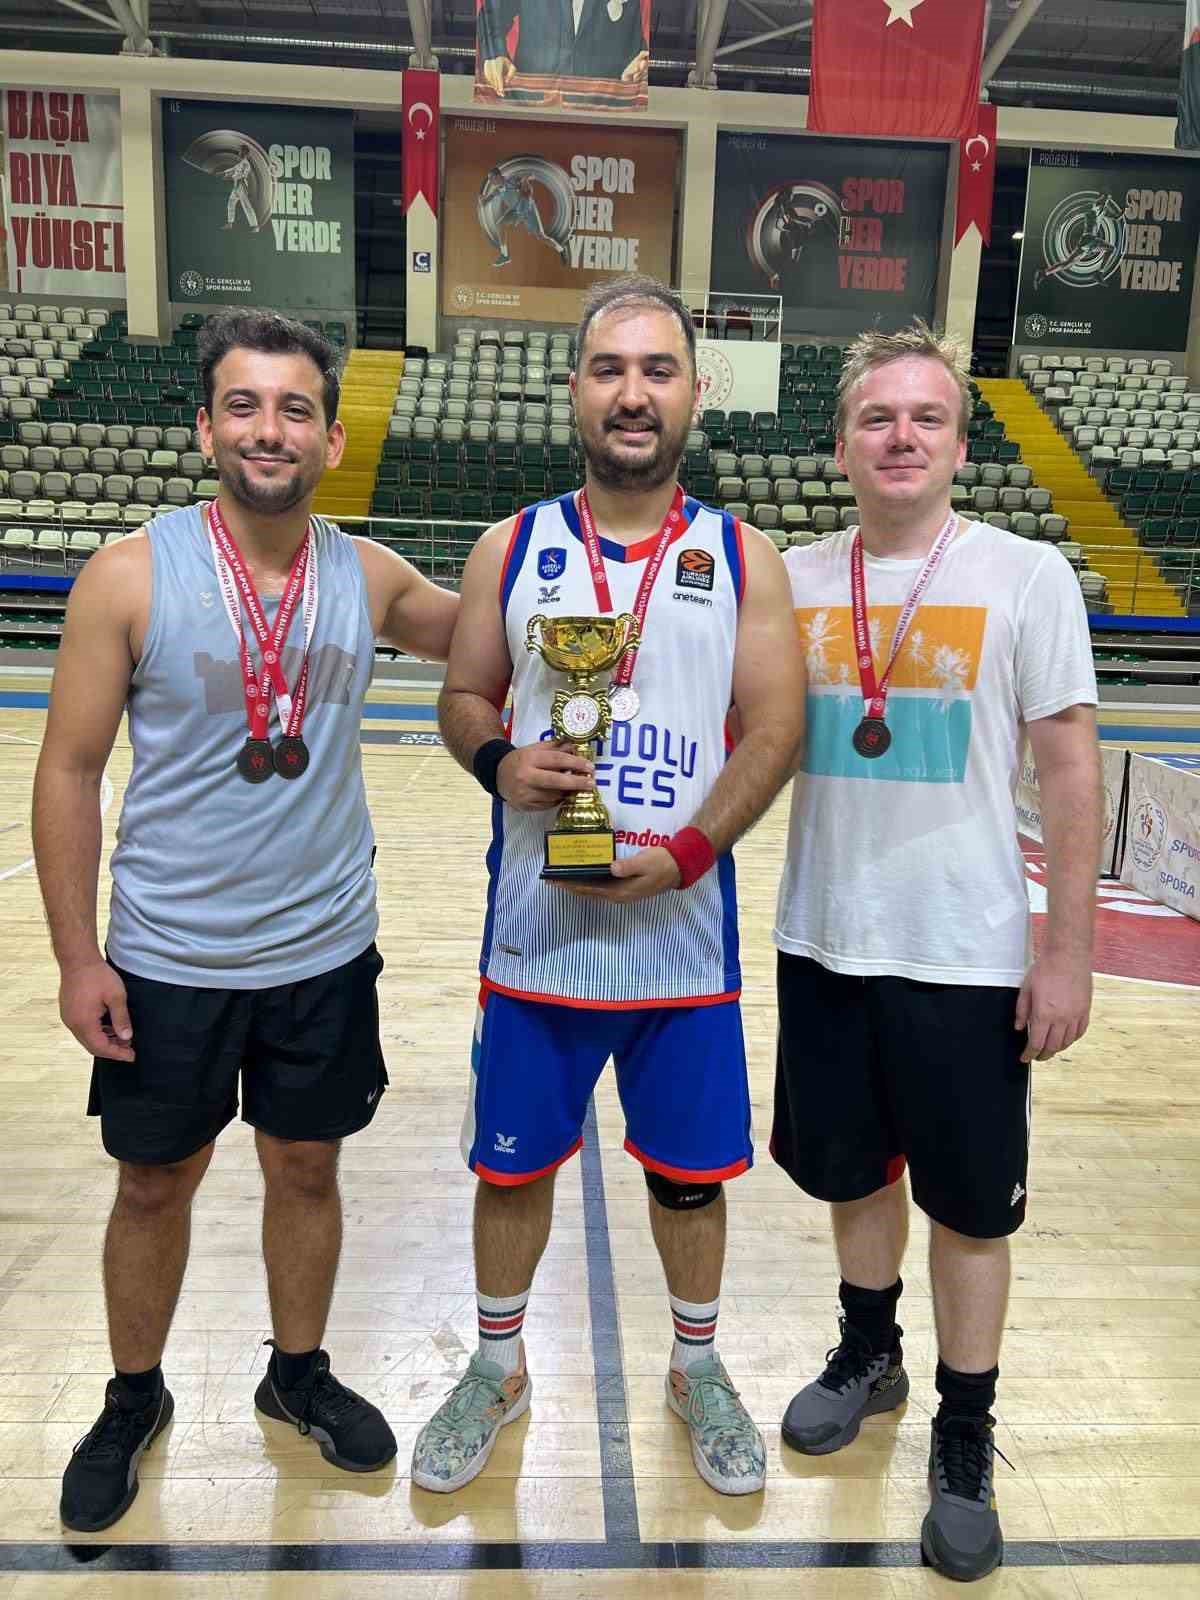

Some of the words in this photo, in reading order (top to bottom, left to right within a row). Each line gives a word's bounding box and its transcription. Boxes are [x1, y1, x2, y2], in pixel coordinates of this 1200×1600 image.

[8, 90, 89, 147] BAŞA
[10, 152, 78, 207] RIYA
[269, 144, 332, 180] SPOR
[570, 155, 635, 194] SPOR
[271, 182, 313, 216] HER
[842, 177, 905, 214] SPOR
[1125, 189, 1183, 221] SPOR
[571, 195, 614, 232] HER
[11, 212, 126, 272] YÜKSEL
[271, 219, 341, 254] YERDE
[840, 216, 882, 251] HER
[1124, 223, 1162, 256] HER
[415, 252, 428, 266] C
[568, 235, 640, 272] YERDE
[838, 255, 907, 291] YERDE
[1120, 259, 1184, 292] YERDE
[644, 579, 652, 590] VE
[647, 561, 658, 580] SPOR
[232, 560, 242, 572] VE
[237, 572, 252, 593] SPOR
[247, 594, 268, 642] BAKANLIĞI
[285, 578, 301, 610] GENÇLİK
[295, 567, 304, 577] VE
[636, 591, 649, 621] ENÇLİK
[673, 592, 712, 607] oneteam
[540, 720, 698, 779] DOLU
[1160, 872, 1195, 897] SPORA
